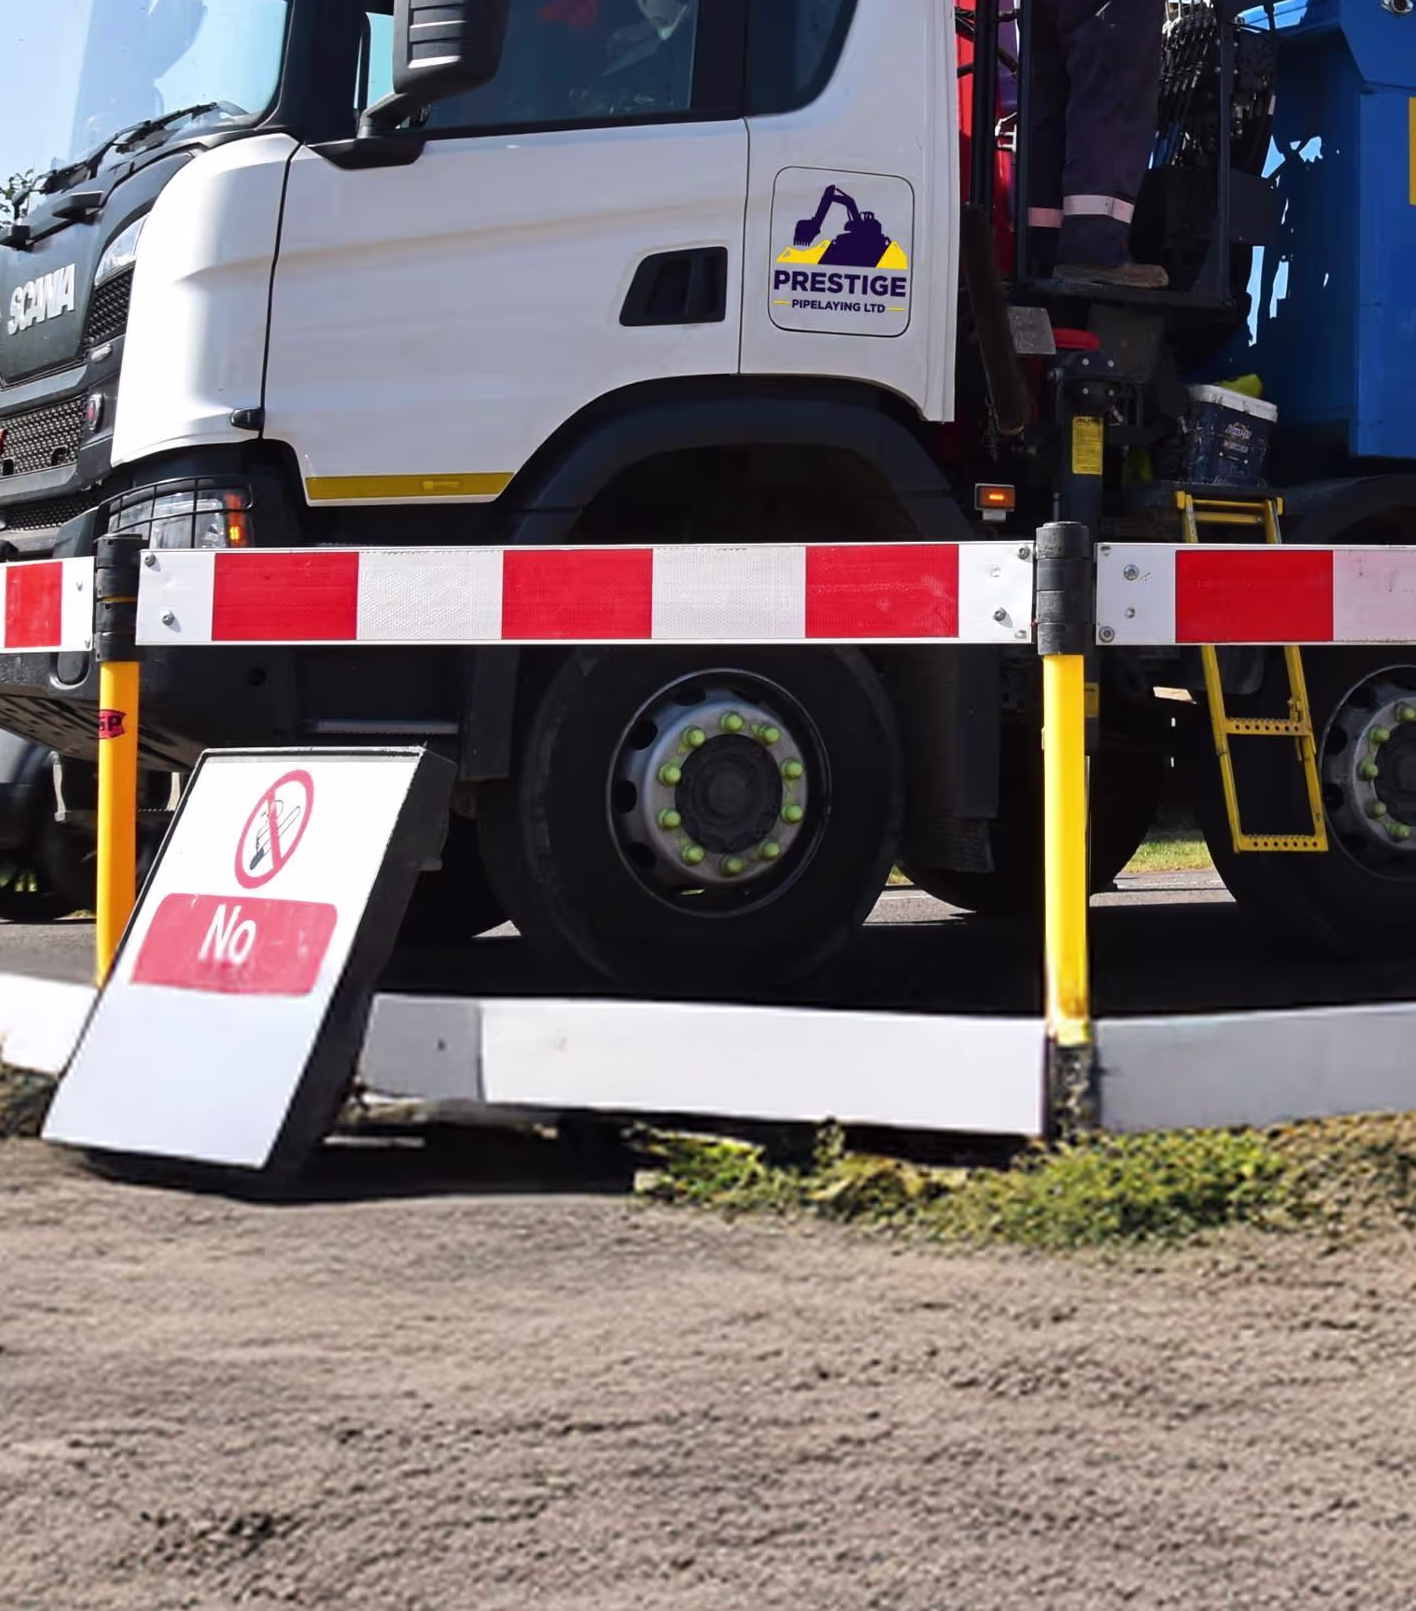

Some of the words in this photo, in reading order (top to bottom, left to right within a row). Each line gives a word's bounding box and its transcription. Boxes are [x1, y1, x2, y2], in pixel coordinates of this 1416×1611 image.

[7, 263, 75, 335] SCANIA
[773, 269, 907, 297] PRESTIGE
[791, 299, 861, 312] PIPELAYING
[864, 303, 886, 313] LTD
[197, 903, 257, 966] No
